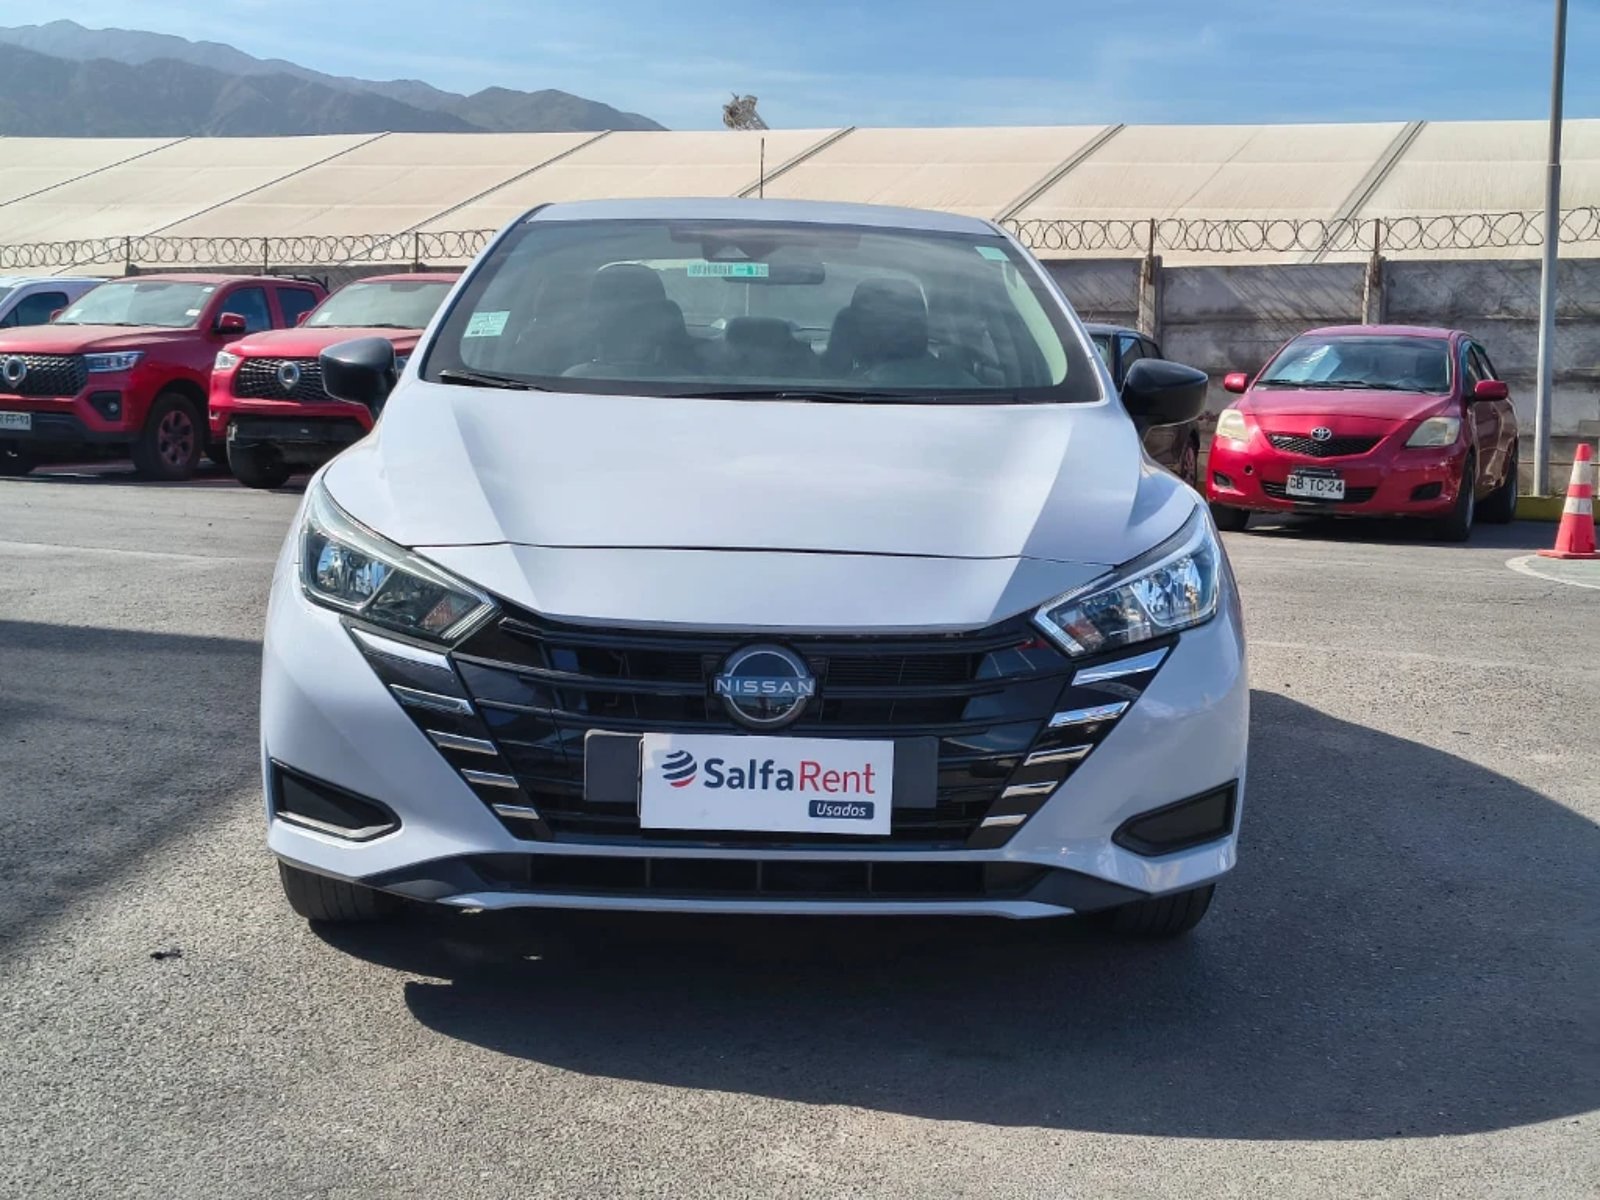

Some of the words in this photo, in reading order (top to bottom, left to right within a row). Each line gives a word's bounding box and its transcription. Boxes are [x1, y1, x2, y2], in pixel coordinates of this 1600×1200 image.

[716, 679, 813, 694] NISSAN
[704, 757, 876, 795] SalfaRent
[816, 802, 867, 818] Usados
